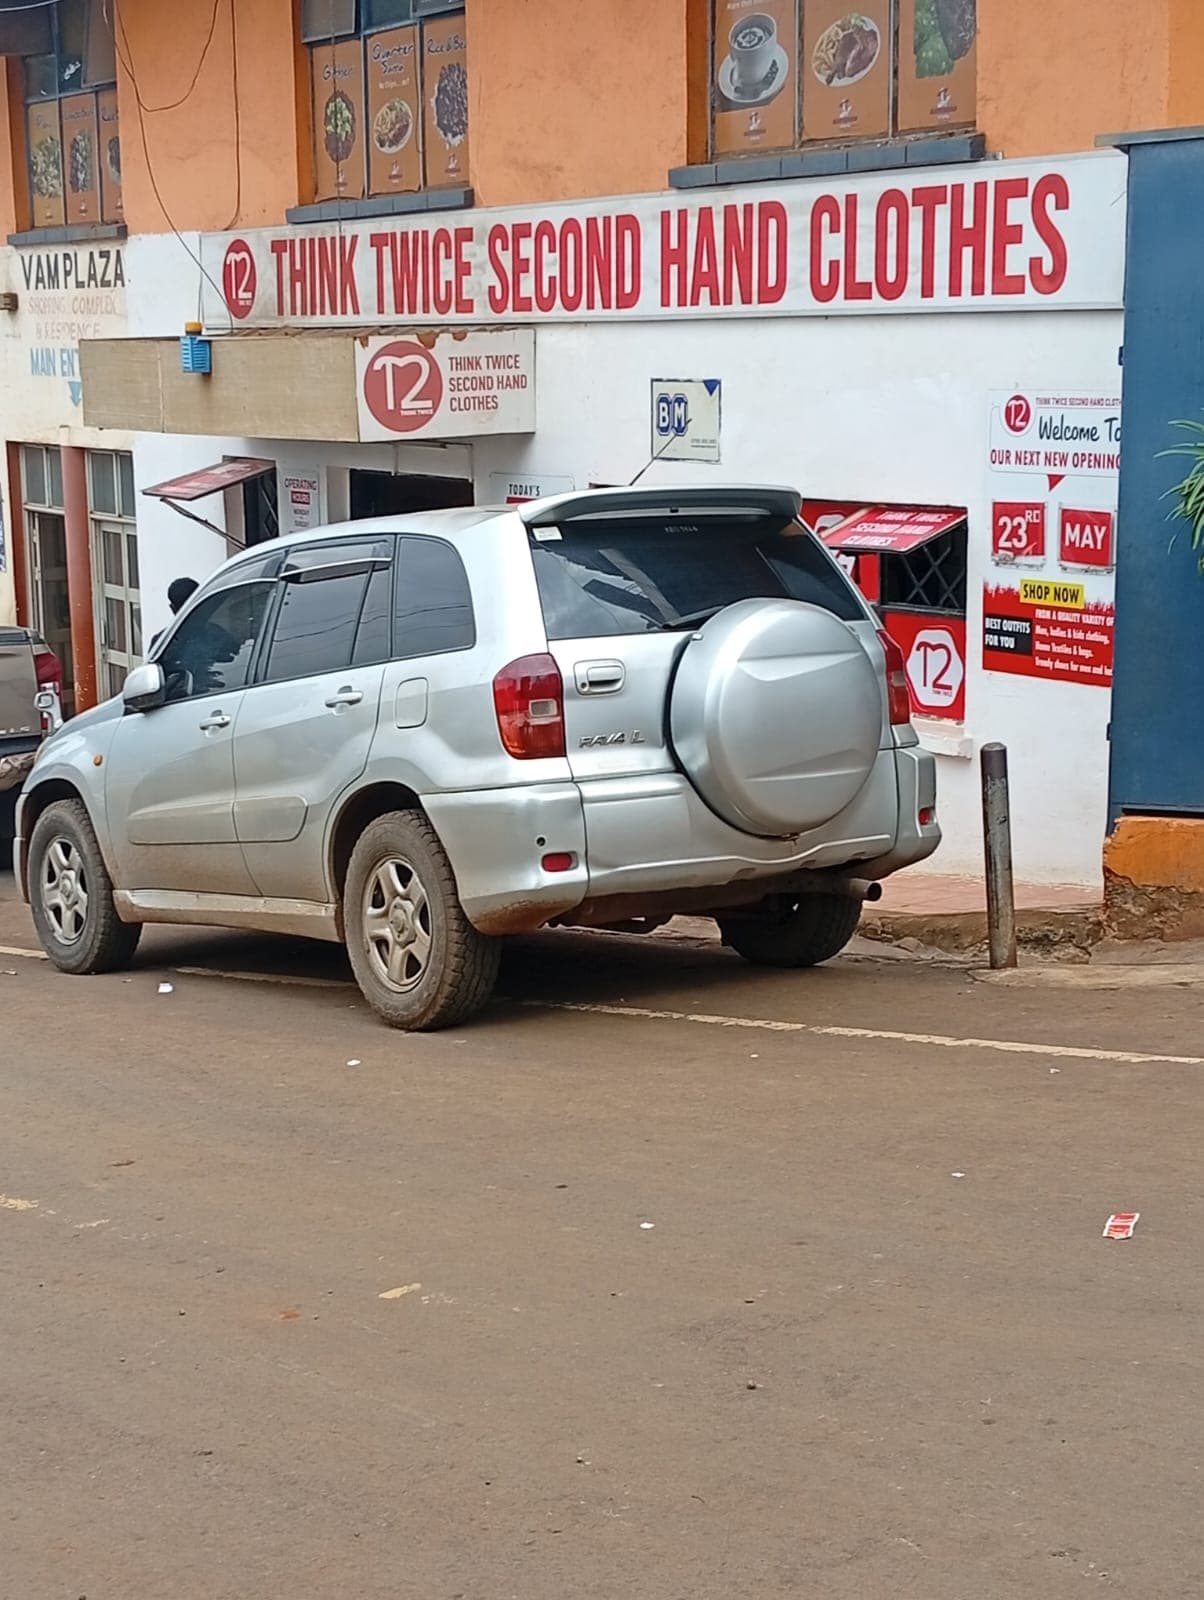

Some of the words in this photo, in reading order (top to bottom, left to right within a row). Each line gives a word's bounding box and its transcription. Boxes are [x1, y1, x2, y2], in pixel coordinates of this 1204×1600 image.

[271, 234, 360, 316] THINK
[370, 226, 474, 315] TWICE
[488, 214, 641, 314] SECOND
[660, 200, 788, 307] HAND
[810, 173, 1070, 302] CLOTHES
[31, 348, 56, 376] MAIN
[449, 356, 482, 372] THINK
[485, 354, 520, 370] TWICE
[449, 376, 493, 392] SECOND
[497, 374, 527, 390] HAND
[450, 396, 498, 412] CLOTHES
[1039, 414, 1100, 442] Welcome
[1104, 417, 1121, 442] To
[990, 449, 1011, 465] OUR
[1015, 450, 1040, 466] NEXT
[1044, 451, 1069, 467] NEW
[509, 484, 540, 496] TODAY'S
[1064, 522, 1106, 550] MAY
[1023, 583, 1050, 600] SHOP
[1053, 586, 1080, 604] NOW
[985, 617, 1001, 630] BEST
[1002, 619, 1031, 634] OUTFITS
[985, 634, 999, 647] FOR
[1000, 636, 1015, 649] YOU
